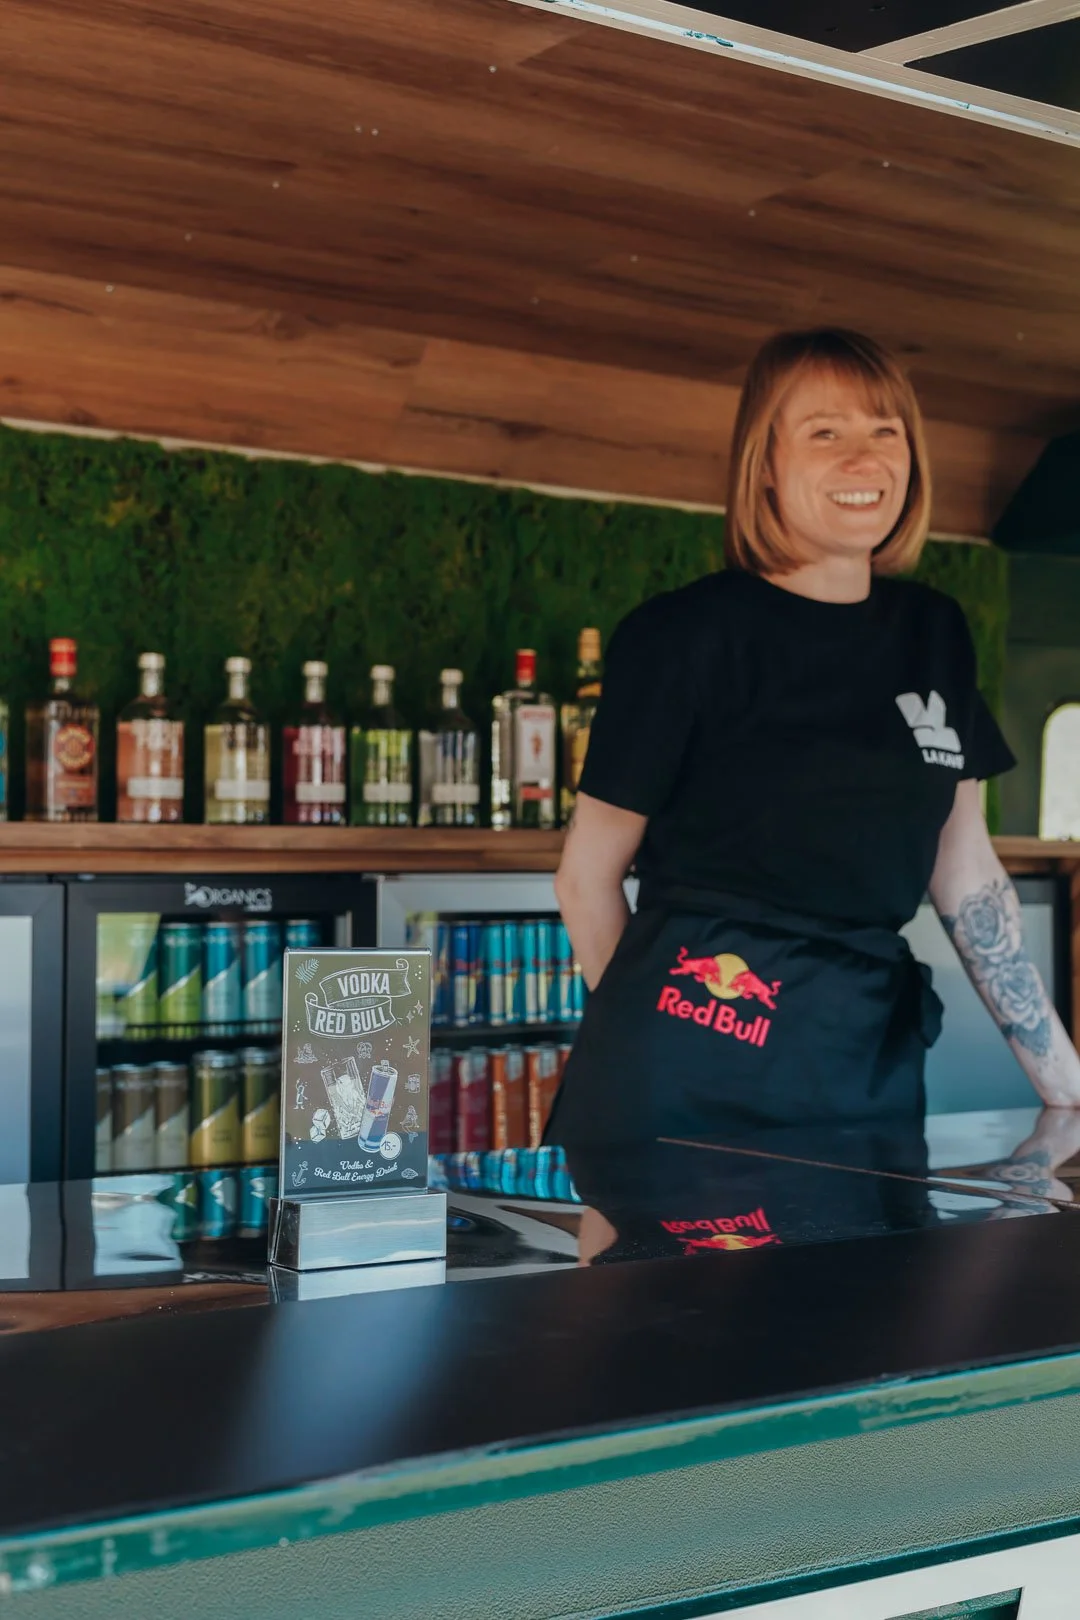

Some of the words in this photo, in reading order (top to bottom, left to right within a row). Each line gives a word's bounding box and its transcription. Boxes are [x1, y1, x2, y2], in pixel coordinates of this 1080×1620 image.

[337, 972, 391, 997] VODKA
[314, 1009, 346, 1034] RED
[350, 1006, 391, 1034] BULL
[657, 985, 717, 1026] Red
[713, 1004, 771, 1047] Bull
[313, 1166, 332, 1179] Red
[332, 1171, 351, 1181] Bull
[351, 1171, 375, 1183] Energy
[375, 1162, 398, 1178] Drink
[340, 1160, 364, 1171] Vodka
[364, 1159, 374, 1169] &
